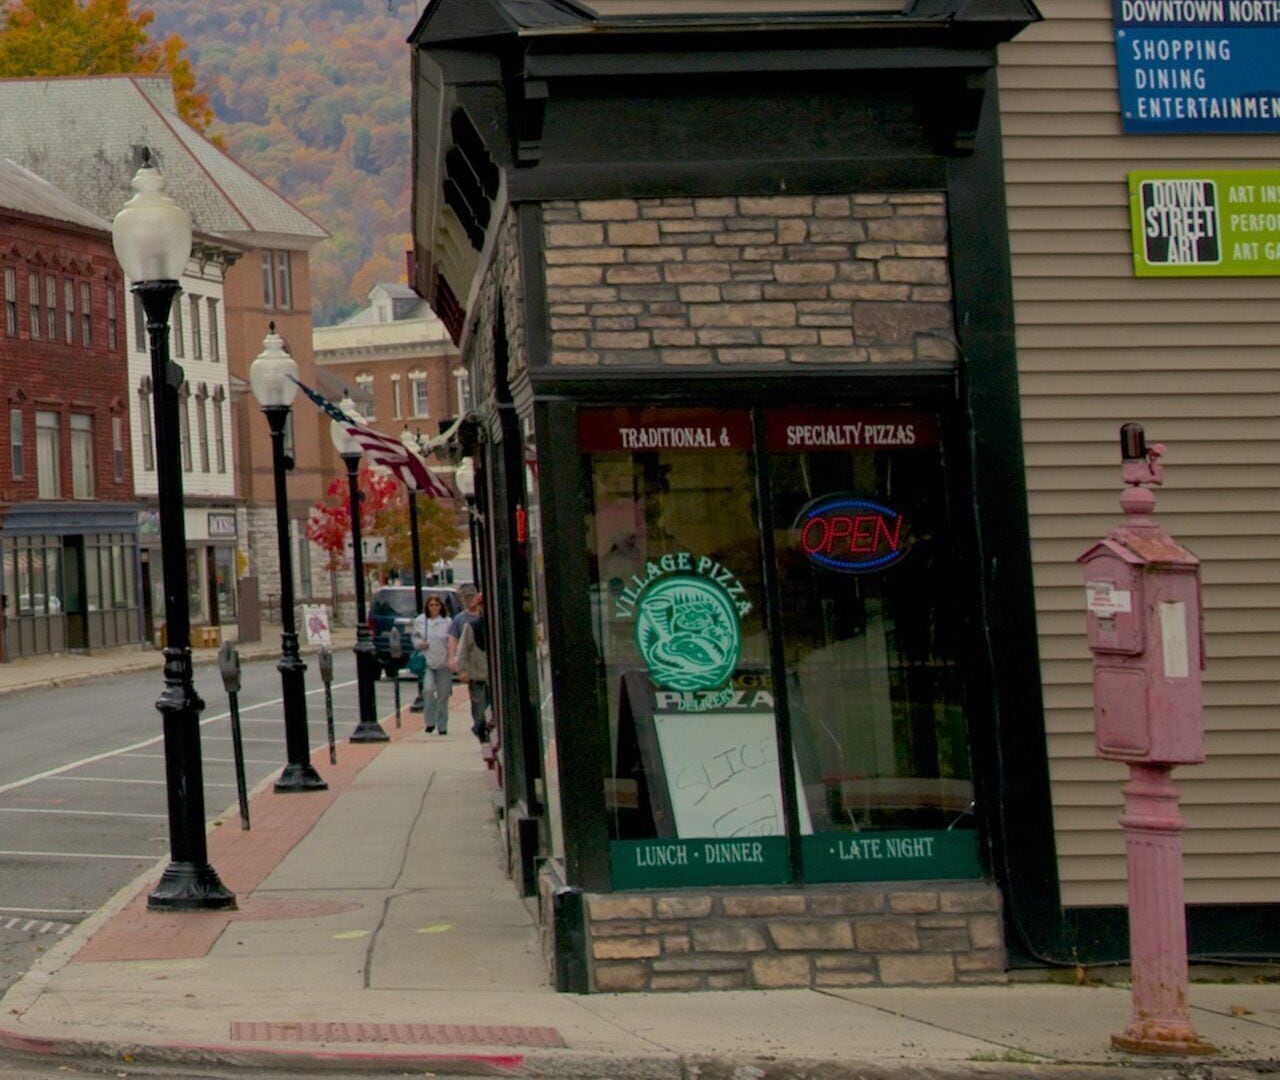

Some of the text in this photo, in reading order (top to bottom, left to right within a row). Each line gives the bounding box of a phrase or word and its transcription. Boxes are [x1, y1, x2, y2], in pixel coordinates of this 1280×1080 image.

[1121, 0, 1280, 22] DOWNTOWN NORTH
[1132, 39, 1231, 61] SHOPPING
[1135, 68, 1206, 90] DINING
[1151, 182, 1205, 208] DOWN
[1228, 185, 1256, 204] ART
[1146, 207, 1214, 238] STREET
[1167, 234, 1200, 262] ART
[1233, 242, 1259, 261] ART
[620, 426, 730, 448] TRADITIONAL &
[787, 422, 915, 445] SPECIALTY PIZZAS
[802, 515, 903, 553] OPEN
[615, 552, 754, 618] VILLAGE PIZZA
[678, 680, 735, 712] DELIVERY
[636, 842, 763, 866] LUNCH DINNER
[840, 837, 934, 860] LATE NIGHT
